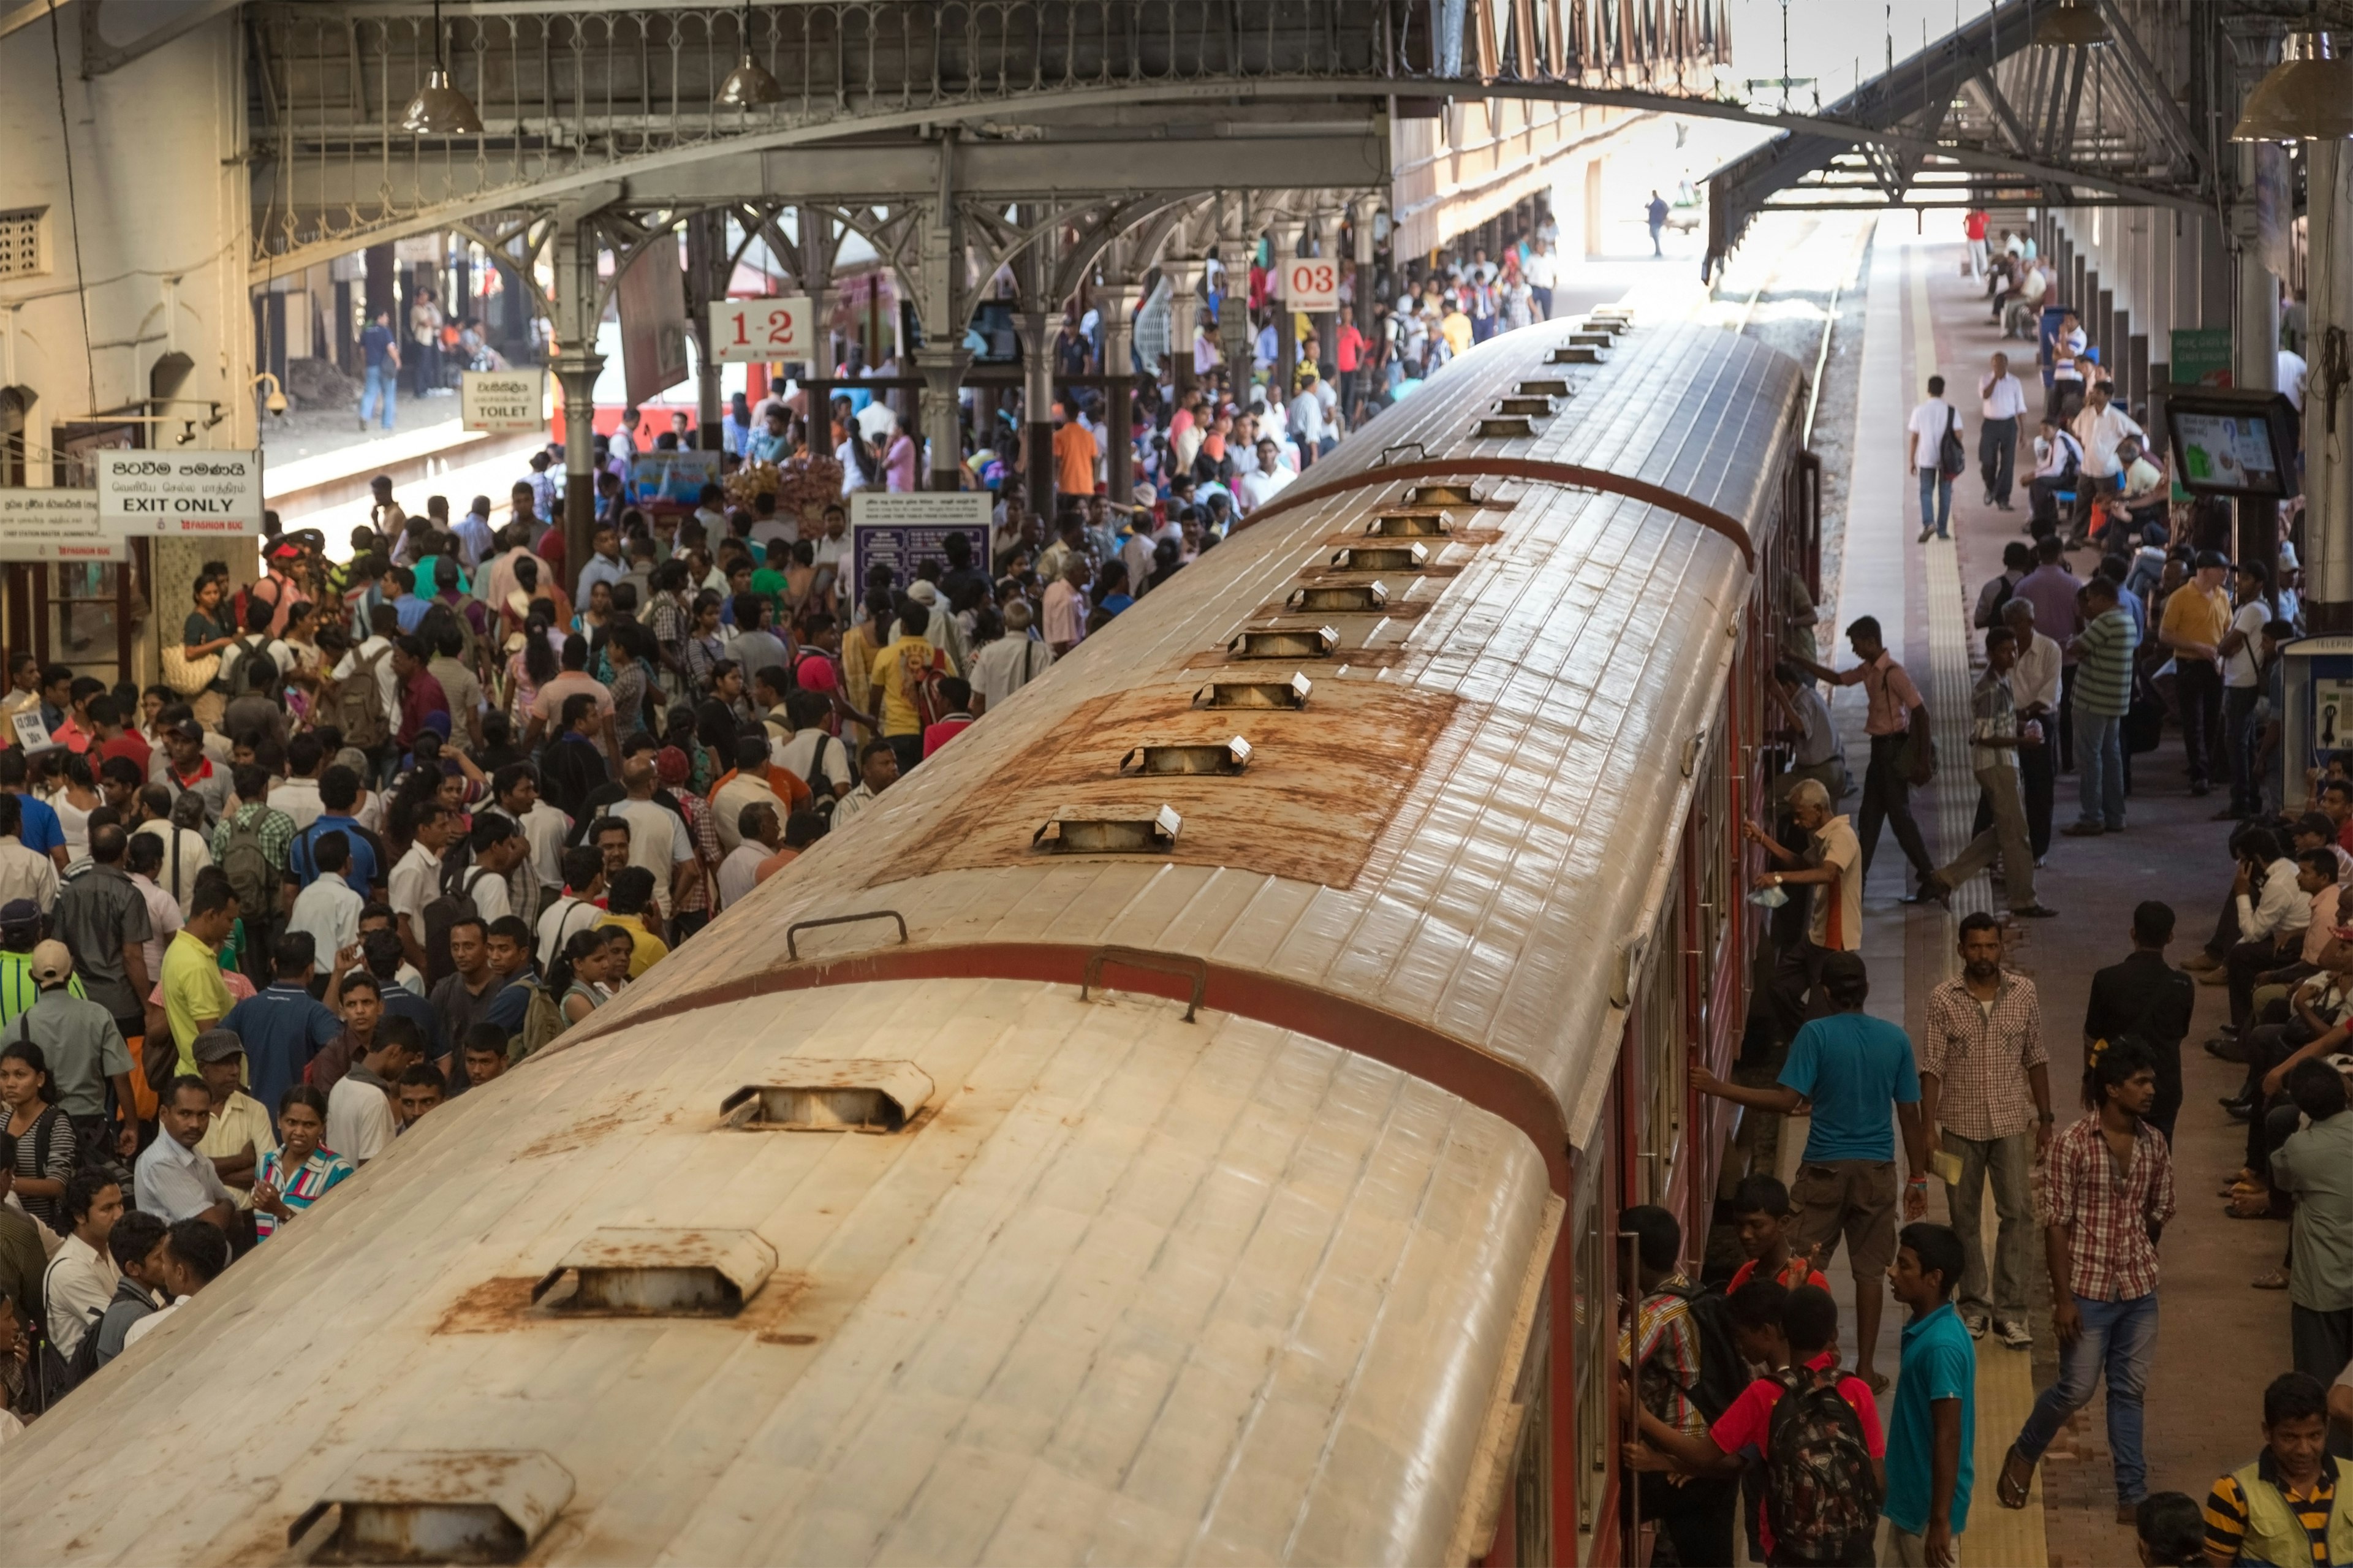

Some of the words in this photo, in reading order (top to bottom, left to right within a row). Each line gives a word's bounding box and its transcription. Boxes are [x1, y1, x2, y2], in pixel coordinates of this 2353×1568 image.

[1292, 265, 1333, 294] 03
[479, 406, 528, 417] TOILET
[123, 498, 169, 512] EXIT
[174, 498, 233, 512] ONLY
[191, 520, 225, 530] FASHION
[227, 521, 243, 530] BUG
